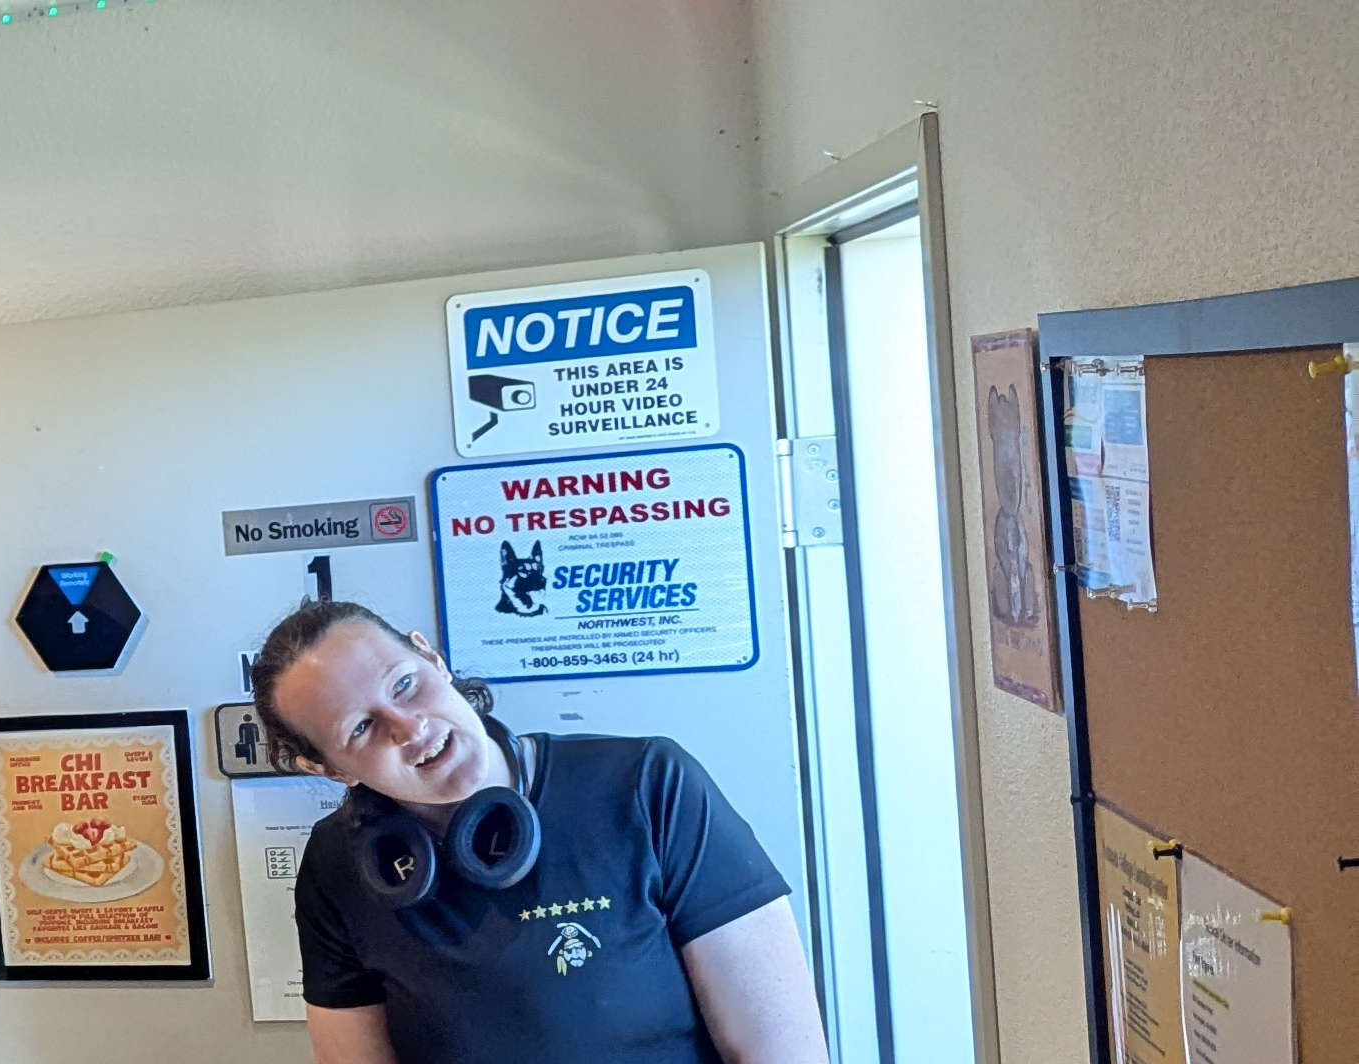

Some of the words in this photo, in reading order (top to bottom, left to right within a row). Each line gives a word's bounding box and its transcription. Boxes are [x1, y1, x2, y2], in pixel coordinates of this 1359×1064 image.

[475, 298, 683, 357] NOTICE
[554, 365, 599, 381] THIS
[606, 360, 658, 377] AREA
[665, 356, 684, 371] IS
[571, 380, 639, 398] UNDER
[645, 377, 668, 391] 24
[560, 400, 616, 417] HOUR
[622, 393, 683, 411] VIDEO
[548, 410, 698, 436] SURVEILLANCE
[501, 467, 671, 501] WARNING
[451, 515, 496, 537] NO
[505, 496, 731, 533] TRESPASSING
[234, 524, 263, 543] No
[268, 517, 360, 541] Smoking
[552, 558, 680, 590] SECURITY
[576, 582, 698, 613] SERVICES
[578, 617, 657, 630] NORTHWEST,
[659, 615, 683, 625] INC.
[520, 652, 628, 669] 1-800-859-3463
[632, 650, 654, 666] (24
[658, 649, 680, 664] hr)
[61, 753, 101, 772] CHI
[16, 771, 151, 793] BREAKFAST
[61, 792, 109, 811] BAR
[489, 832, 505, 856] L
[393, 855, 415, 881] R
